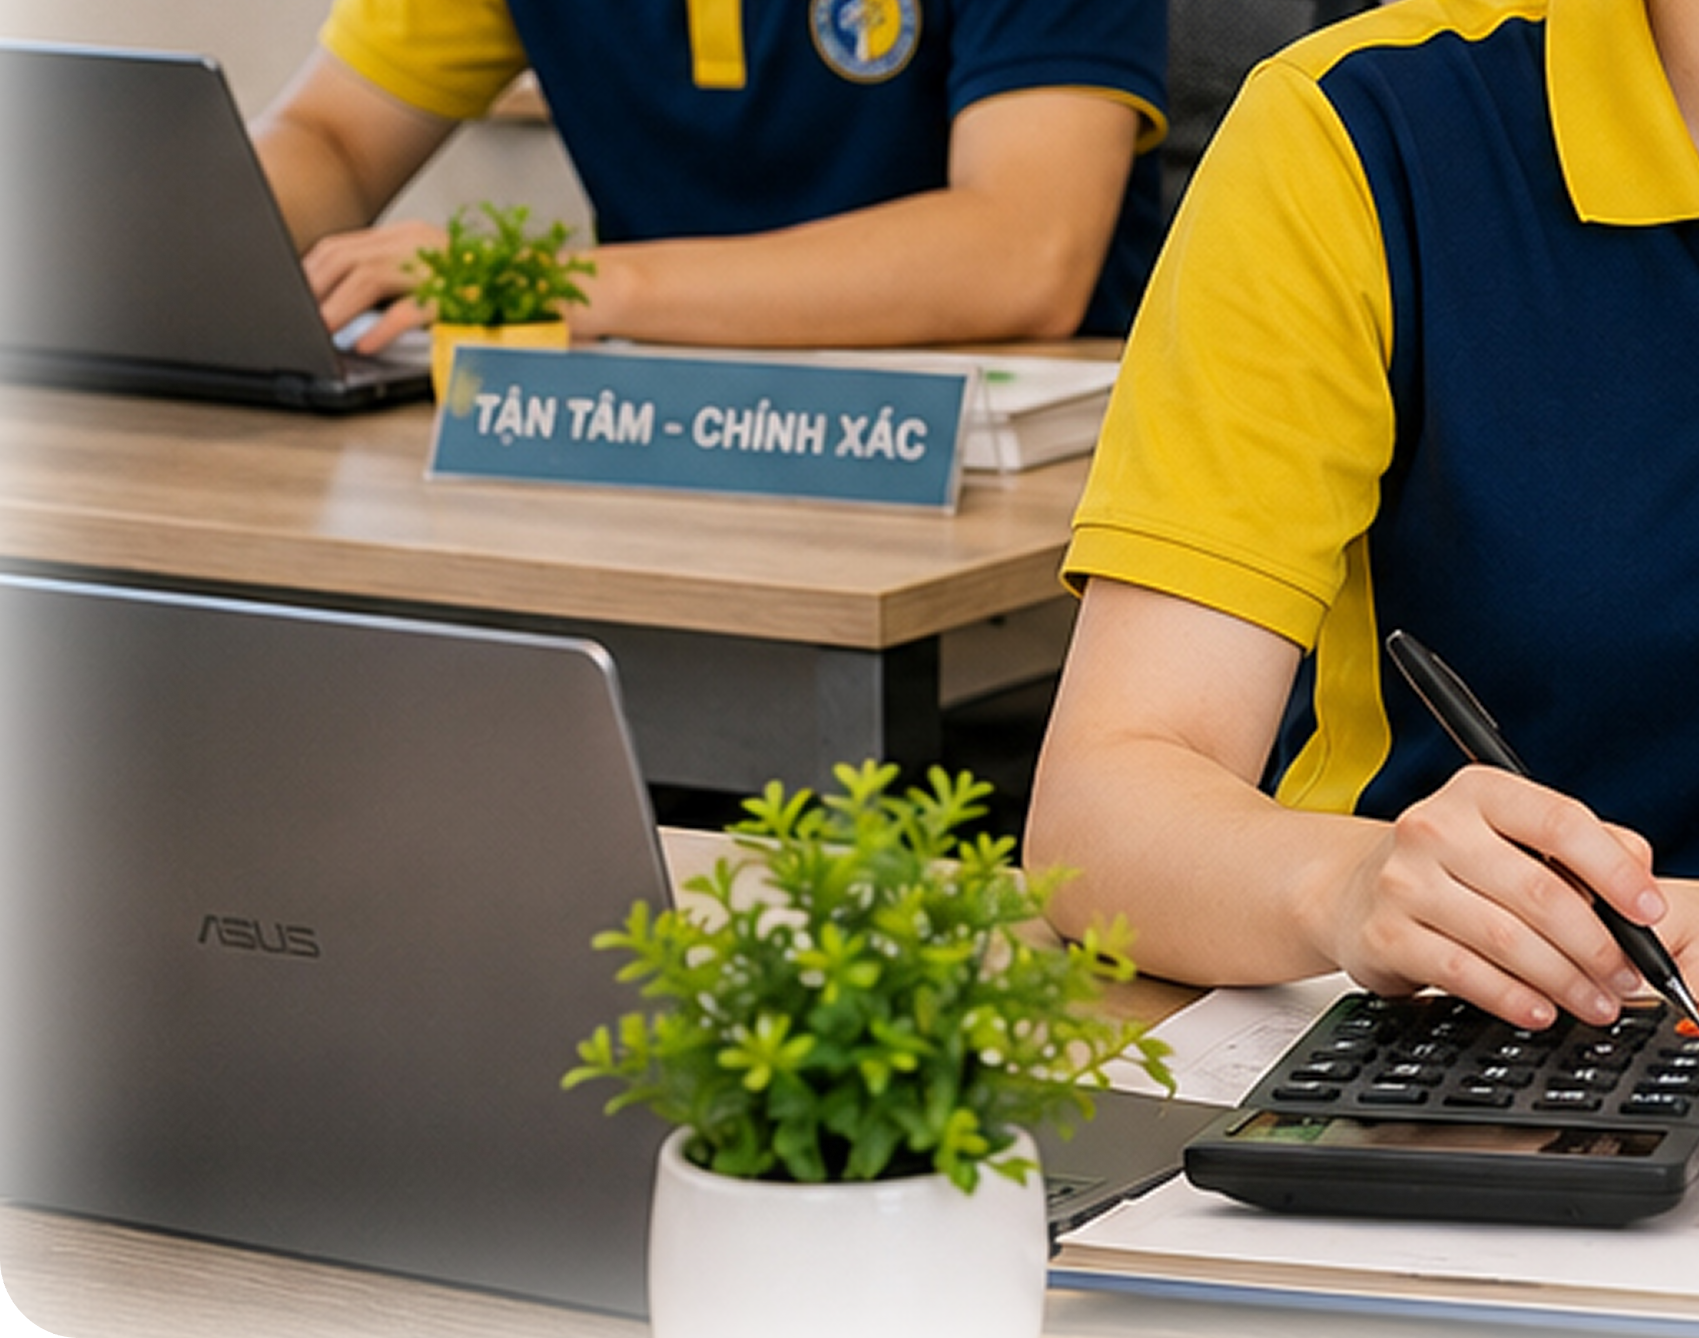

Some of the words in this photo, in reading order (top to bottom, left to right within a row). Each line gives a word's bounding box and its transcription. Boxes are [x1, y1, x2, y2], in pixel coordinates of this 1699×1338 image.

[475, 385, 557, 446] TẬN
[567, 390, 655, 446] TÂM
[692, 400, 826, 456] CHÍNH
[835, 407, 928, 461] XÁC
[198, 914, 320, 958] ASUS
